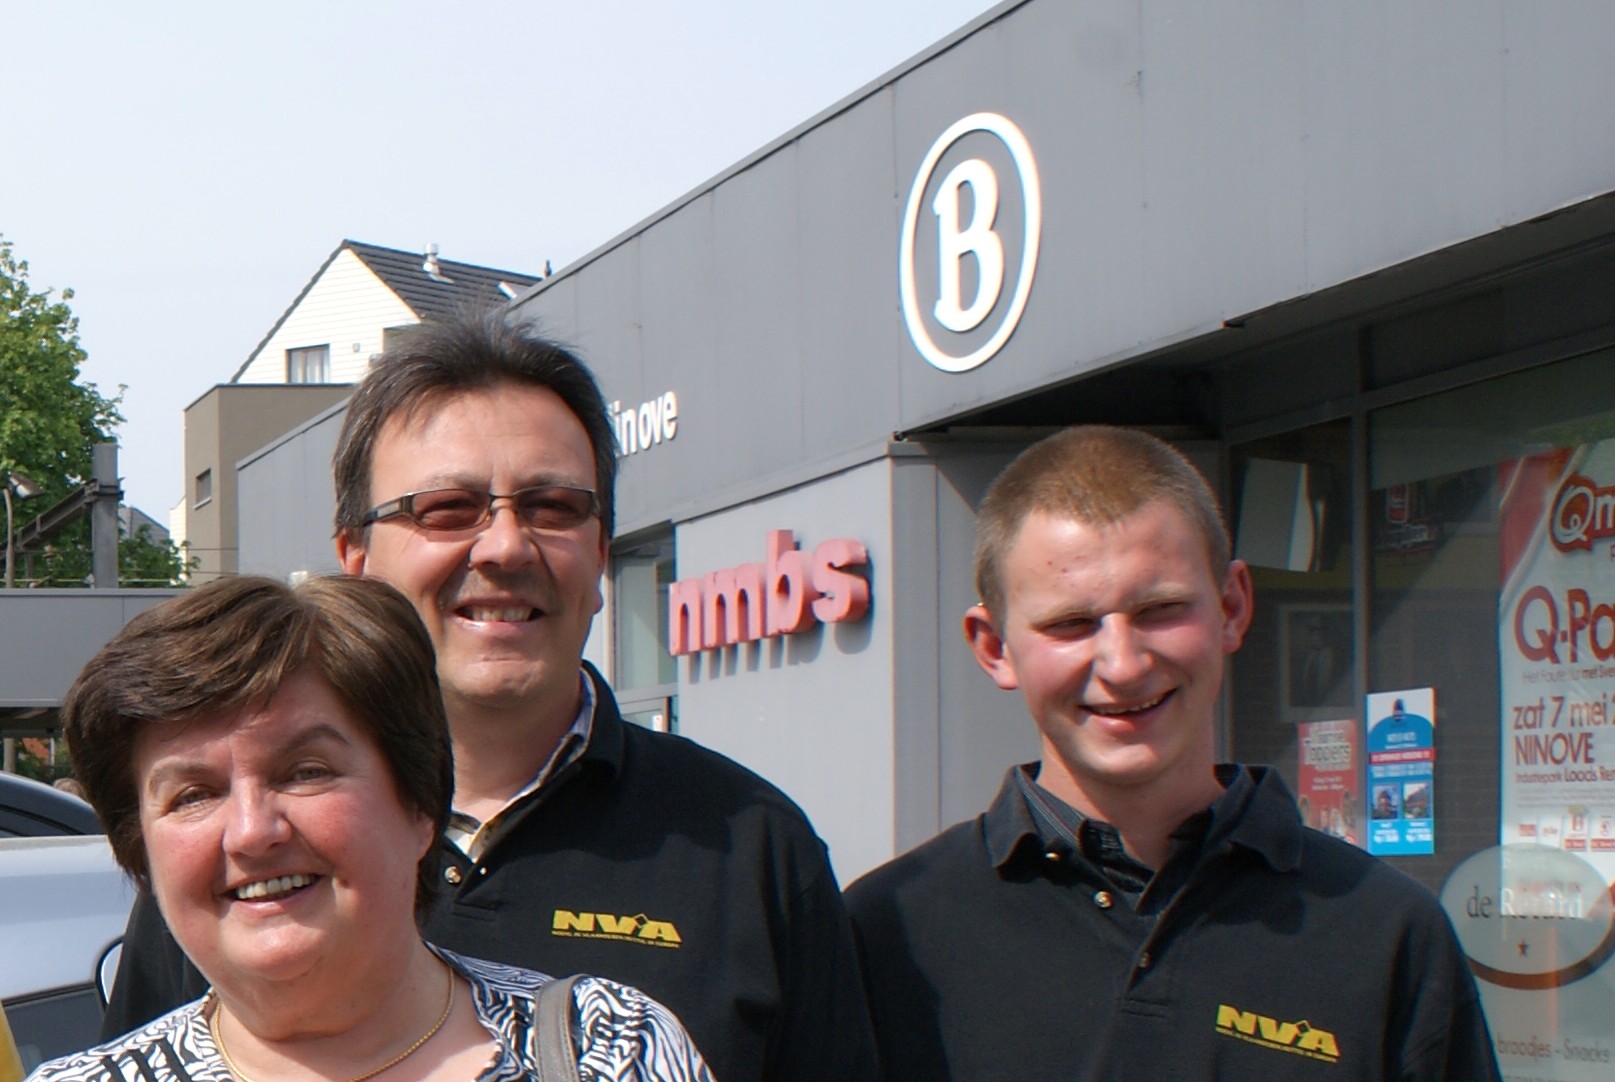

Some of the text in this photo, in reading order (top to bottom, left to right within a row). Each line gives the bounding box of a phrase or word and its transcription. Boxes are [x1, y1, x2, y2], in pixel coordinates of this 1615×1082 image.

[932, 158, 1004, 332] B
[607, 391, 678, 457] inove
[669, 529, 872, 656] nmbs
[1512, 692, 1607, 730] zat 7 mei
[1515, 732, 1595, 765] NINOVE
[1466, 884, 1492, 919] de
